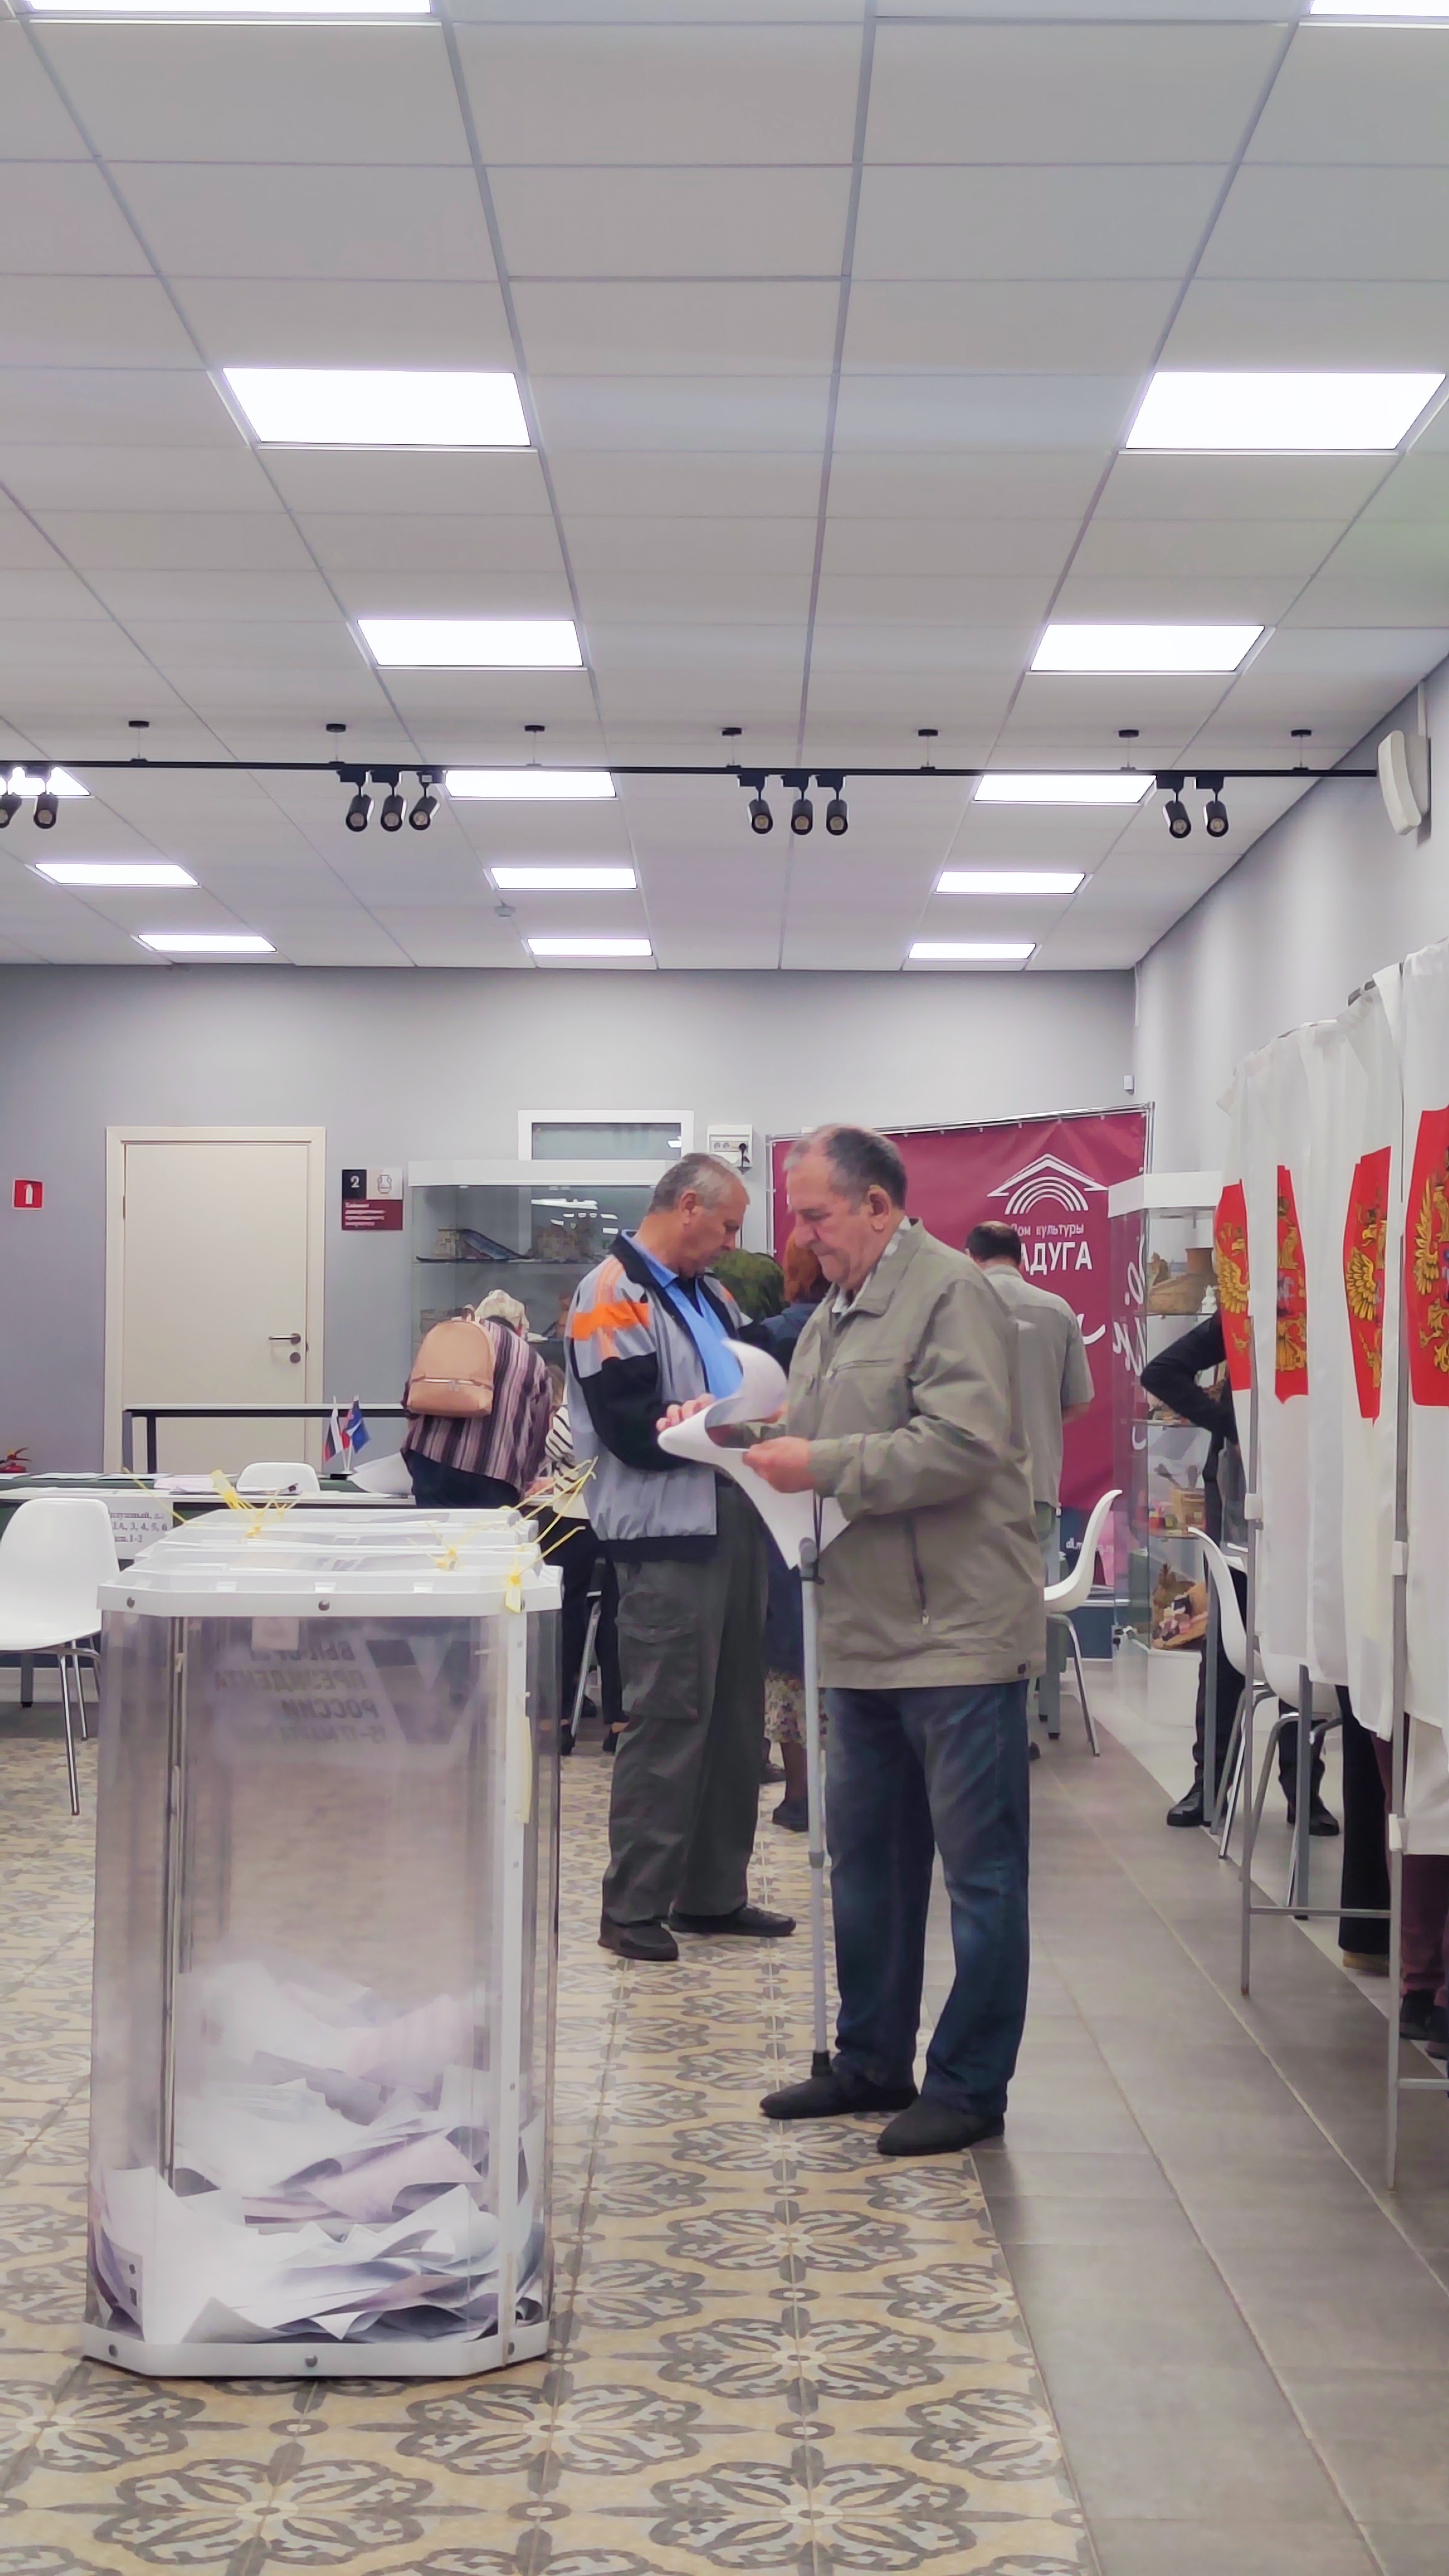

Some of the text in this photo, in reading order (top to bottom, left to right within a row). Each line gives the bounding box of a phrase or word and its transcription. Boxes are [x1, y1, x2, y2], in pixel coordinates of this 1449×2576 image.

[350, 1175, 360, 1188] 2
[1035, 1223, 1084, 1240] культуры
[1020, 1241, 1093, 1276] АДУГА
